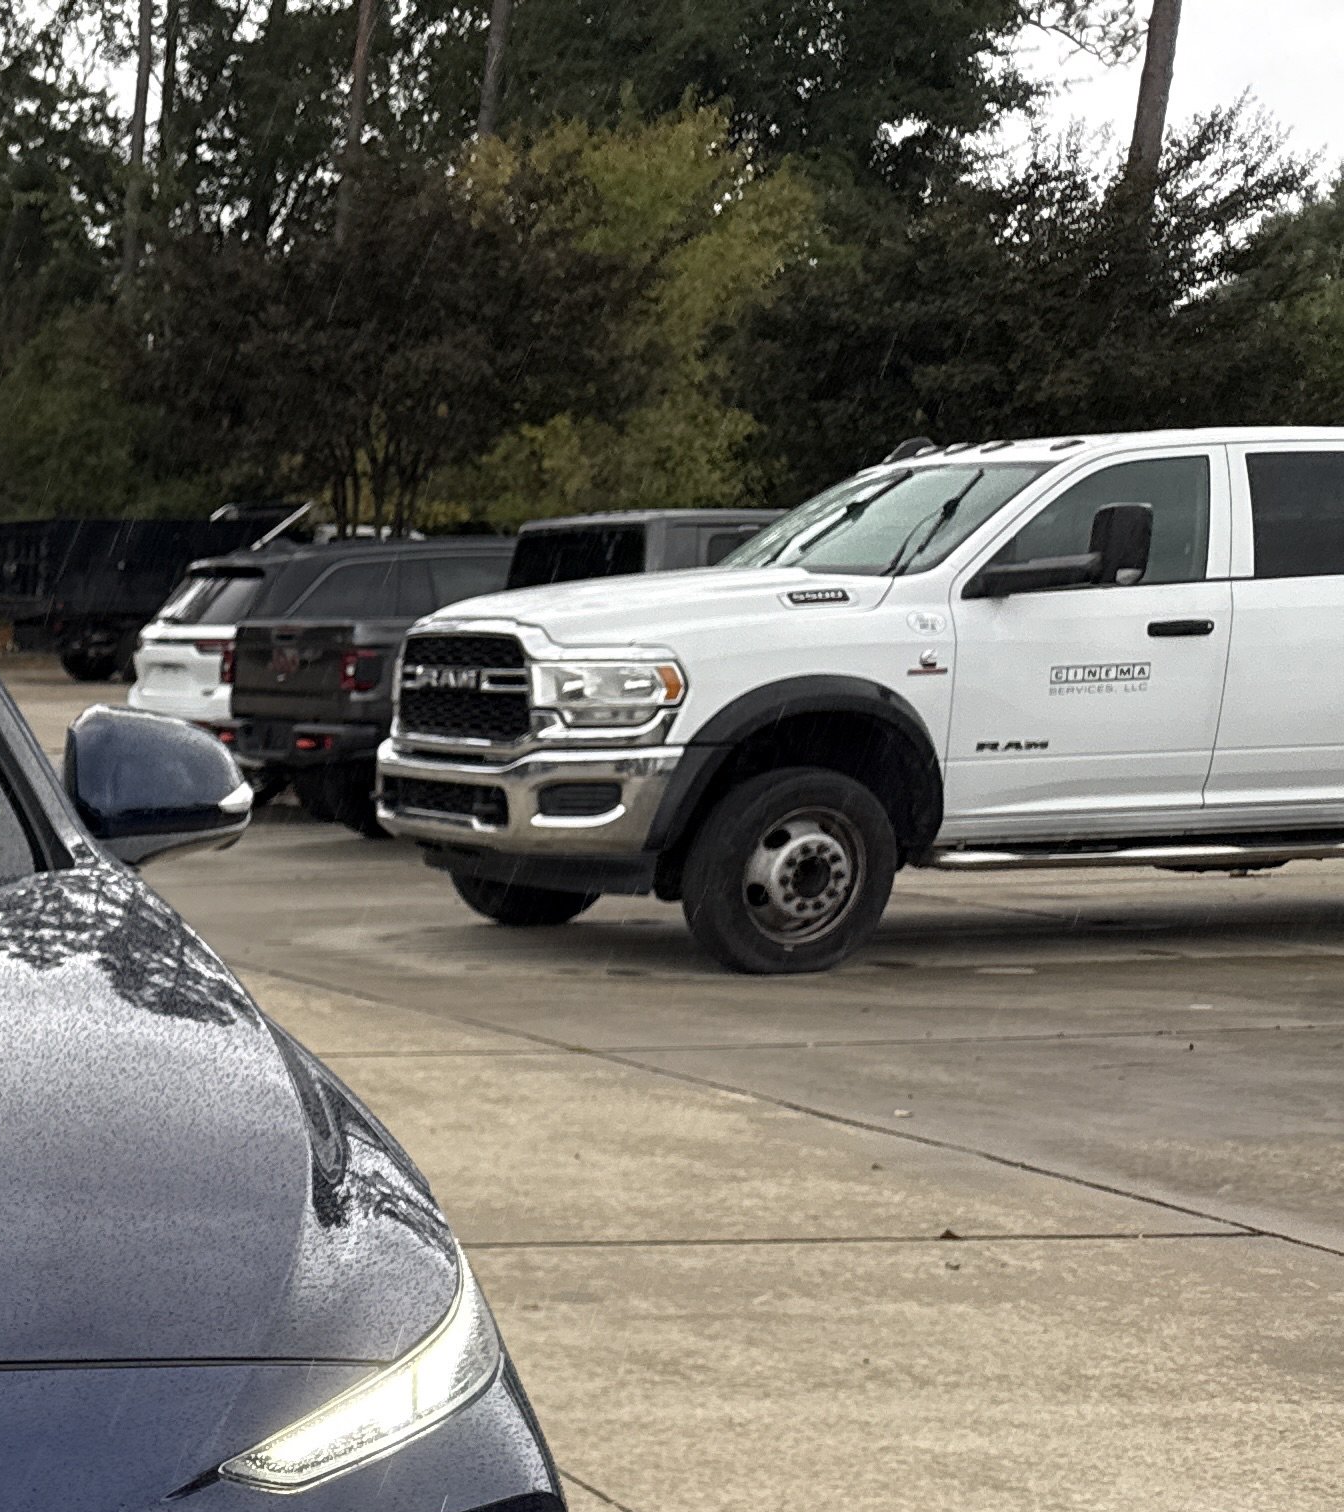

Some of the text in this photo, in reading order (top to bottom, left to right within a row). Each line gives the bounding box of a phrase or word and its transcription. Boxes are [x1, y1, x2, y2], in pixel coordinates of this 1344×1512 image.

[1053, 665, 1148, 682] CINEMA
[1123, 682, 1148, 693] LLC
[975, 741, 1049, 752] RAM
